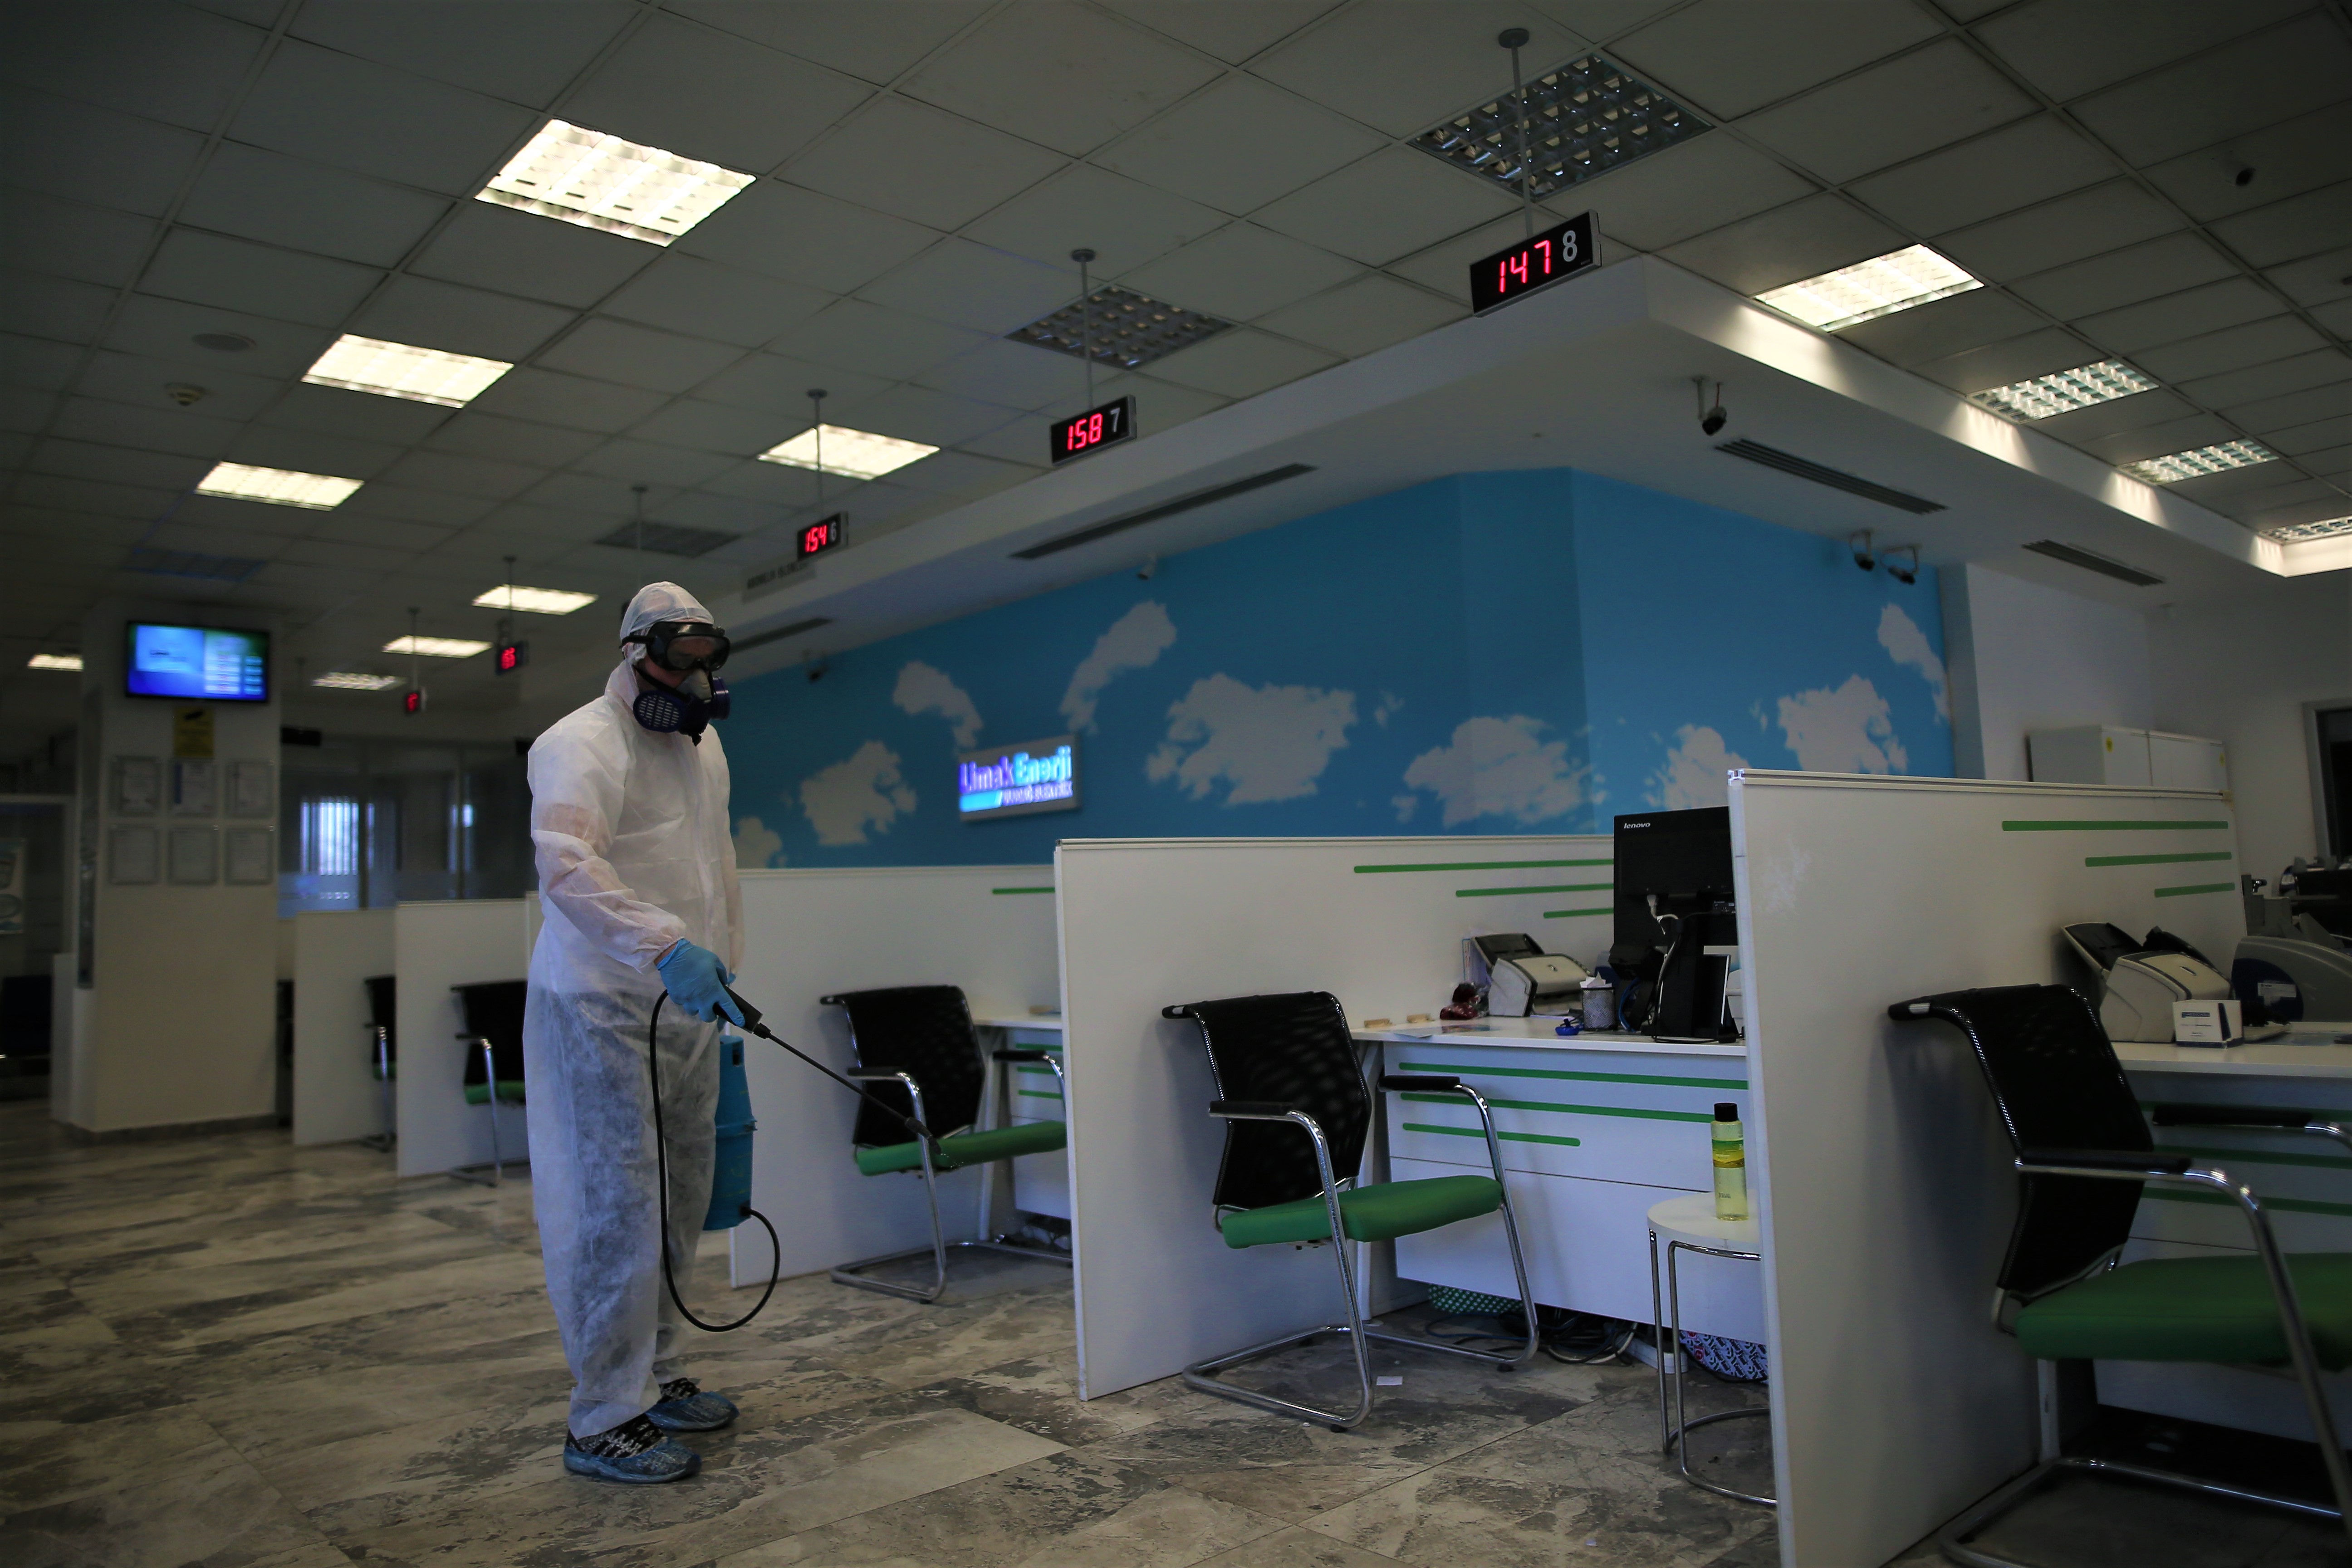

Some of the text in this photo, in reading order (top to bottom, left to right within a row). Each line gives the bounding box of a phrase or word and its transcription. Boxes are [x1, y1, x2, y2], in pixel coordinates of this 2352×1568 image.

[1563, 230, 1578, 262] 8
[1499, 240, 1551, 293] 147
[1068, 413, 1102, 451] 158
[1110, 407, 1120, 432] 7
[805, 524, 828, 552] 154
